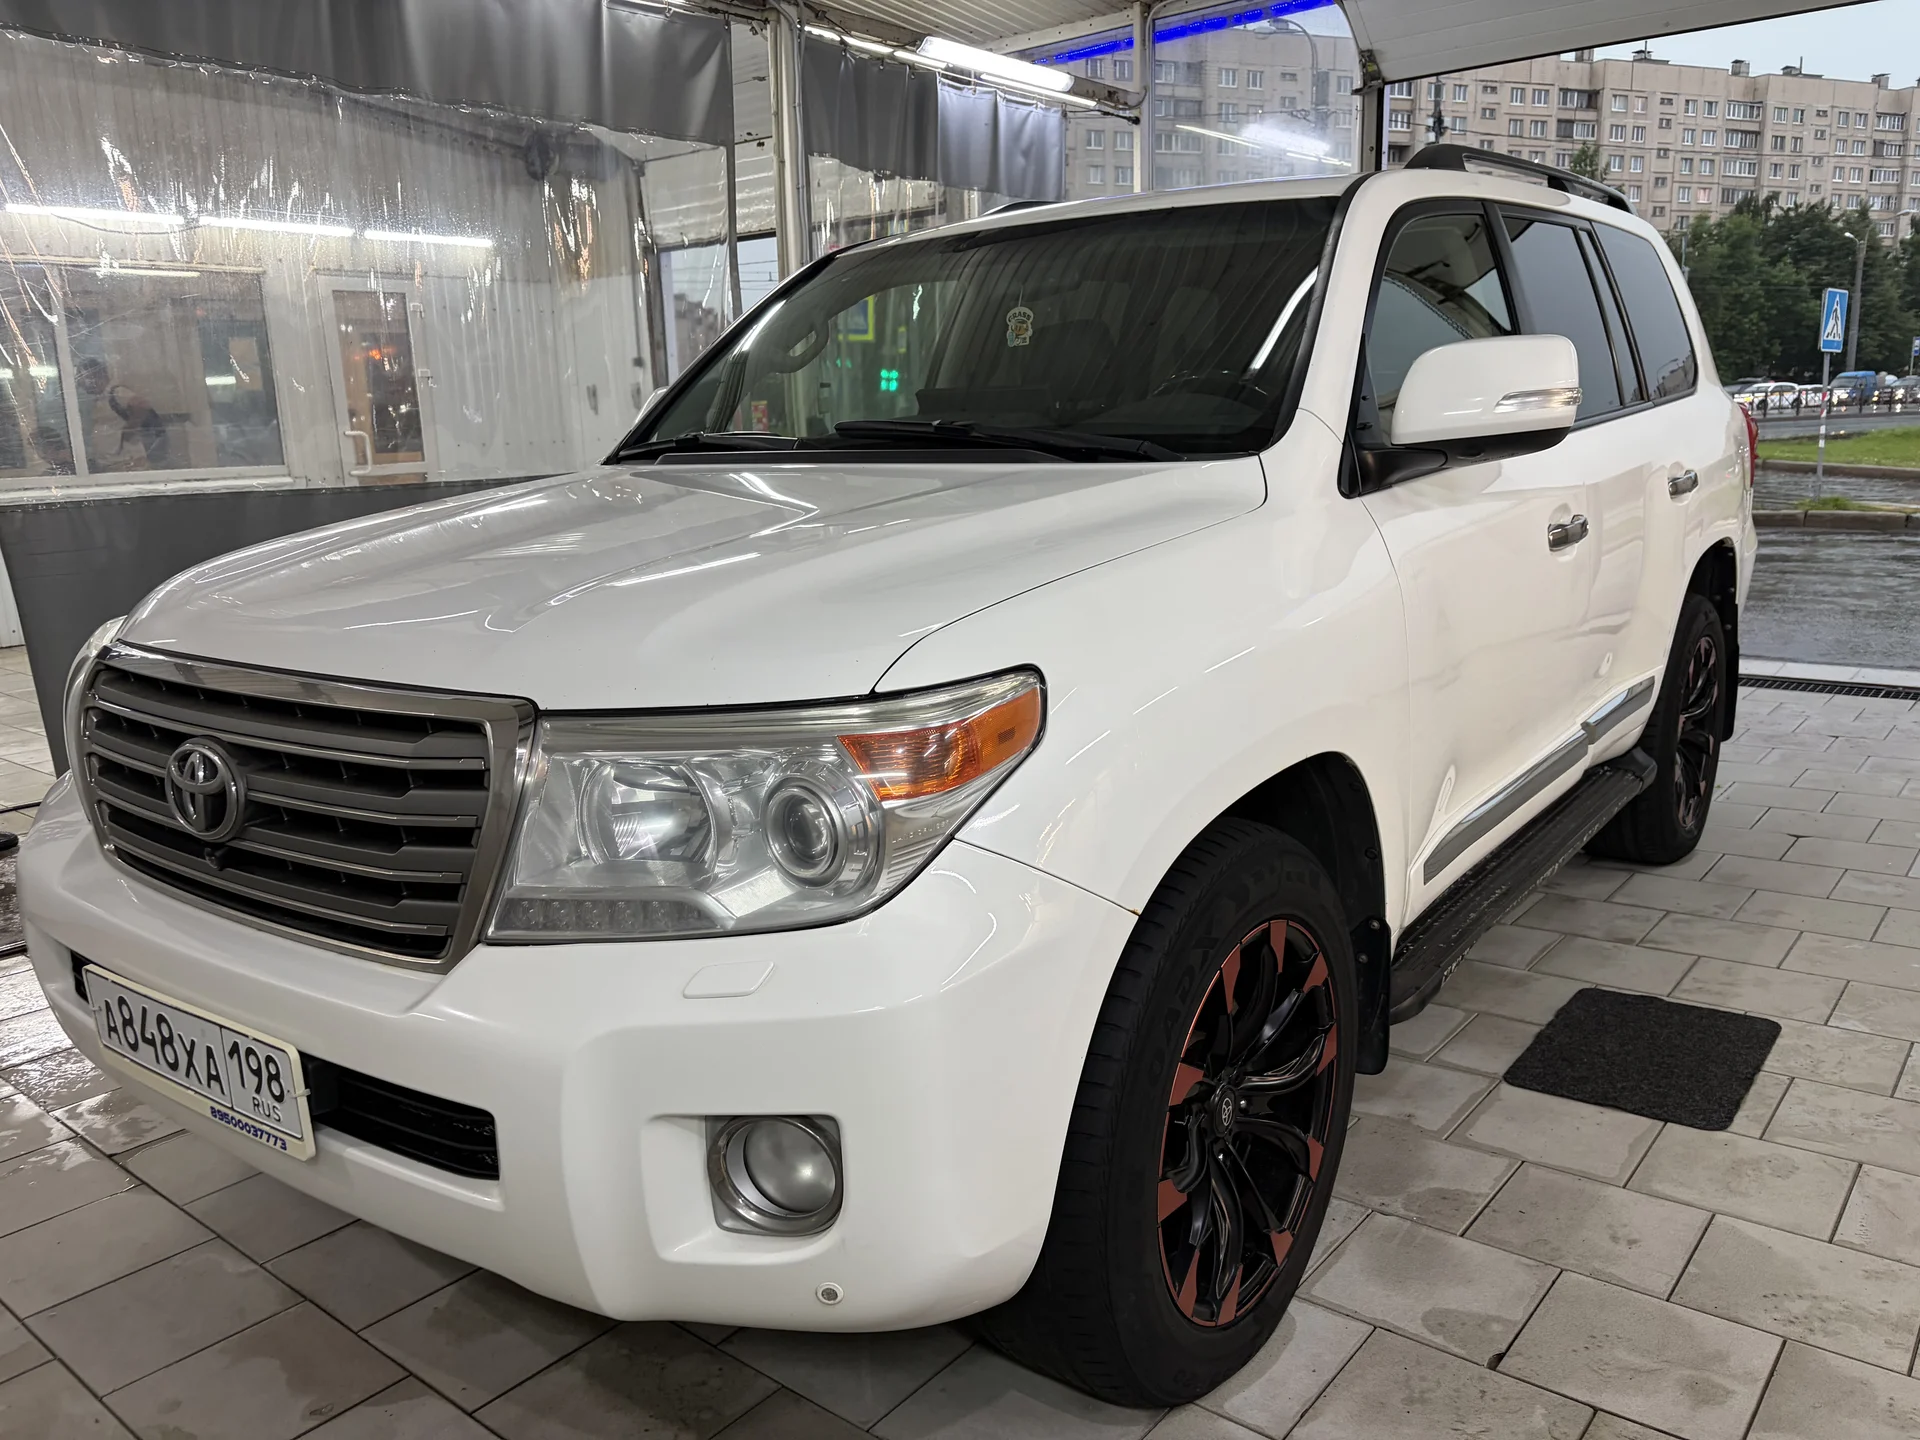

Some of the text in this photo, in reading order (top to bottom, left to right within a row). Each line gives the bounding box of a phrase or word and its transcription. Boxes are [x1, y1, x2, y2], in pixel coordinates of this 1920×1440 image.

[1008, 311, 1031, 323] GRASS
[228, 1039, 285, 1103] 198
[252, 1096, 282, 1122] RUS
[210, 1105, 287, 1151] 89500037773
